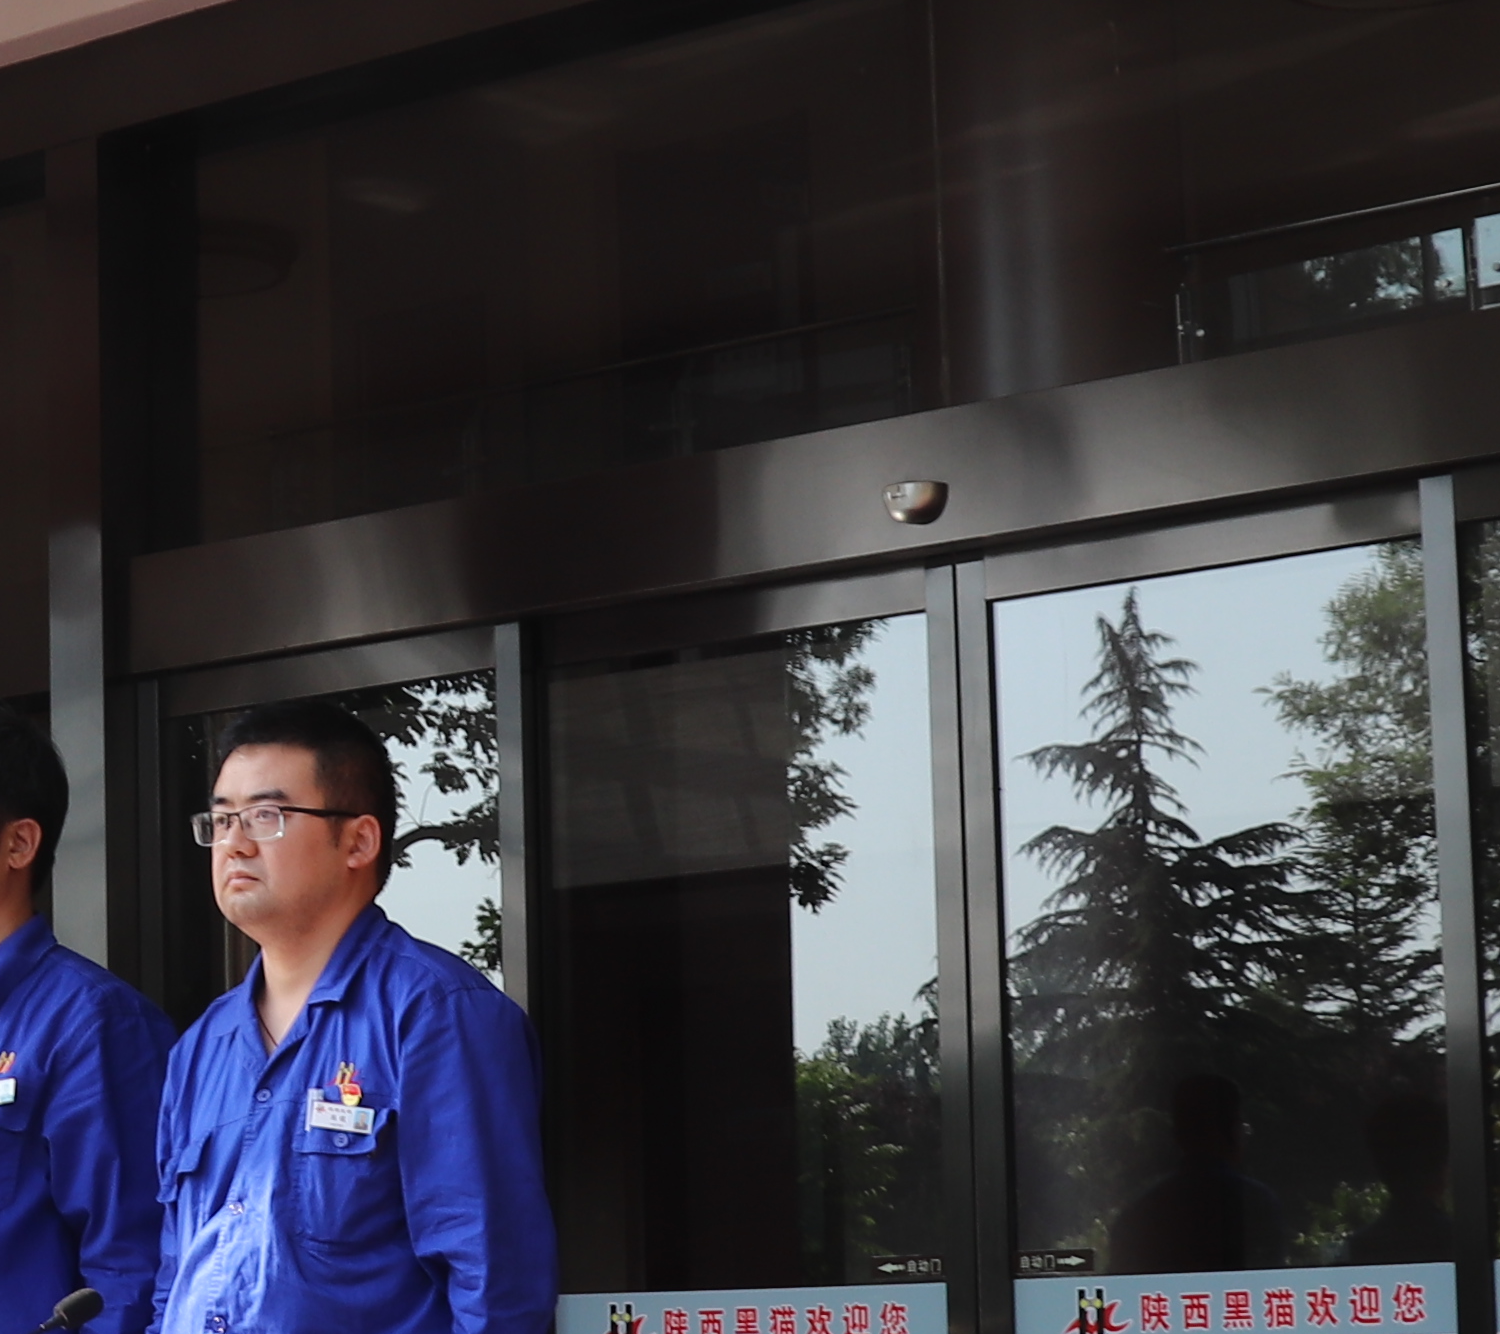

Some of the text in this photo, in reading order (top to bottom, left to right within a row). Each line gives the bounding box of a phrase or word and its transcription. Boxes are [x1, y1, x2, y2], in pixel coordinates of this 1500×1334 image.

[1140, 1282, 1426, 1331] 陕西黑猫欢迎您
